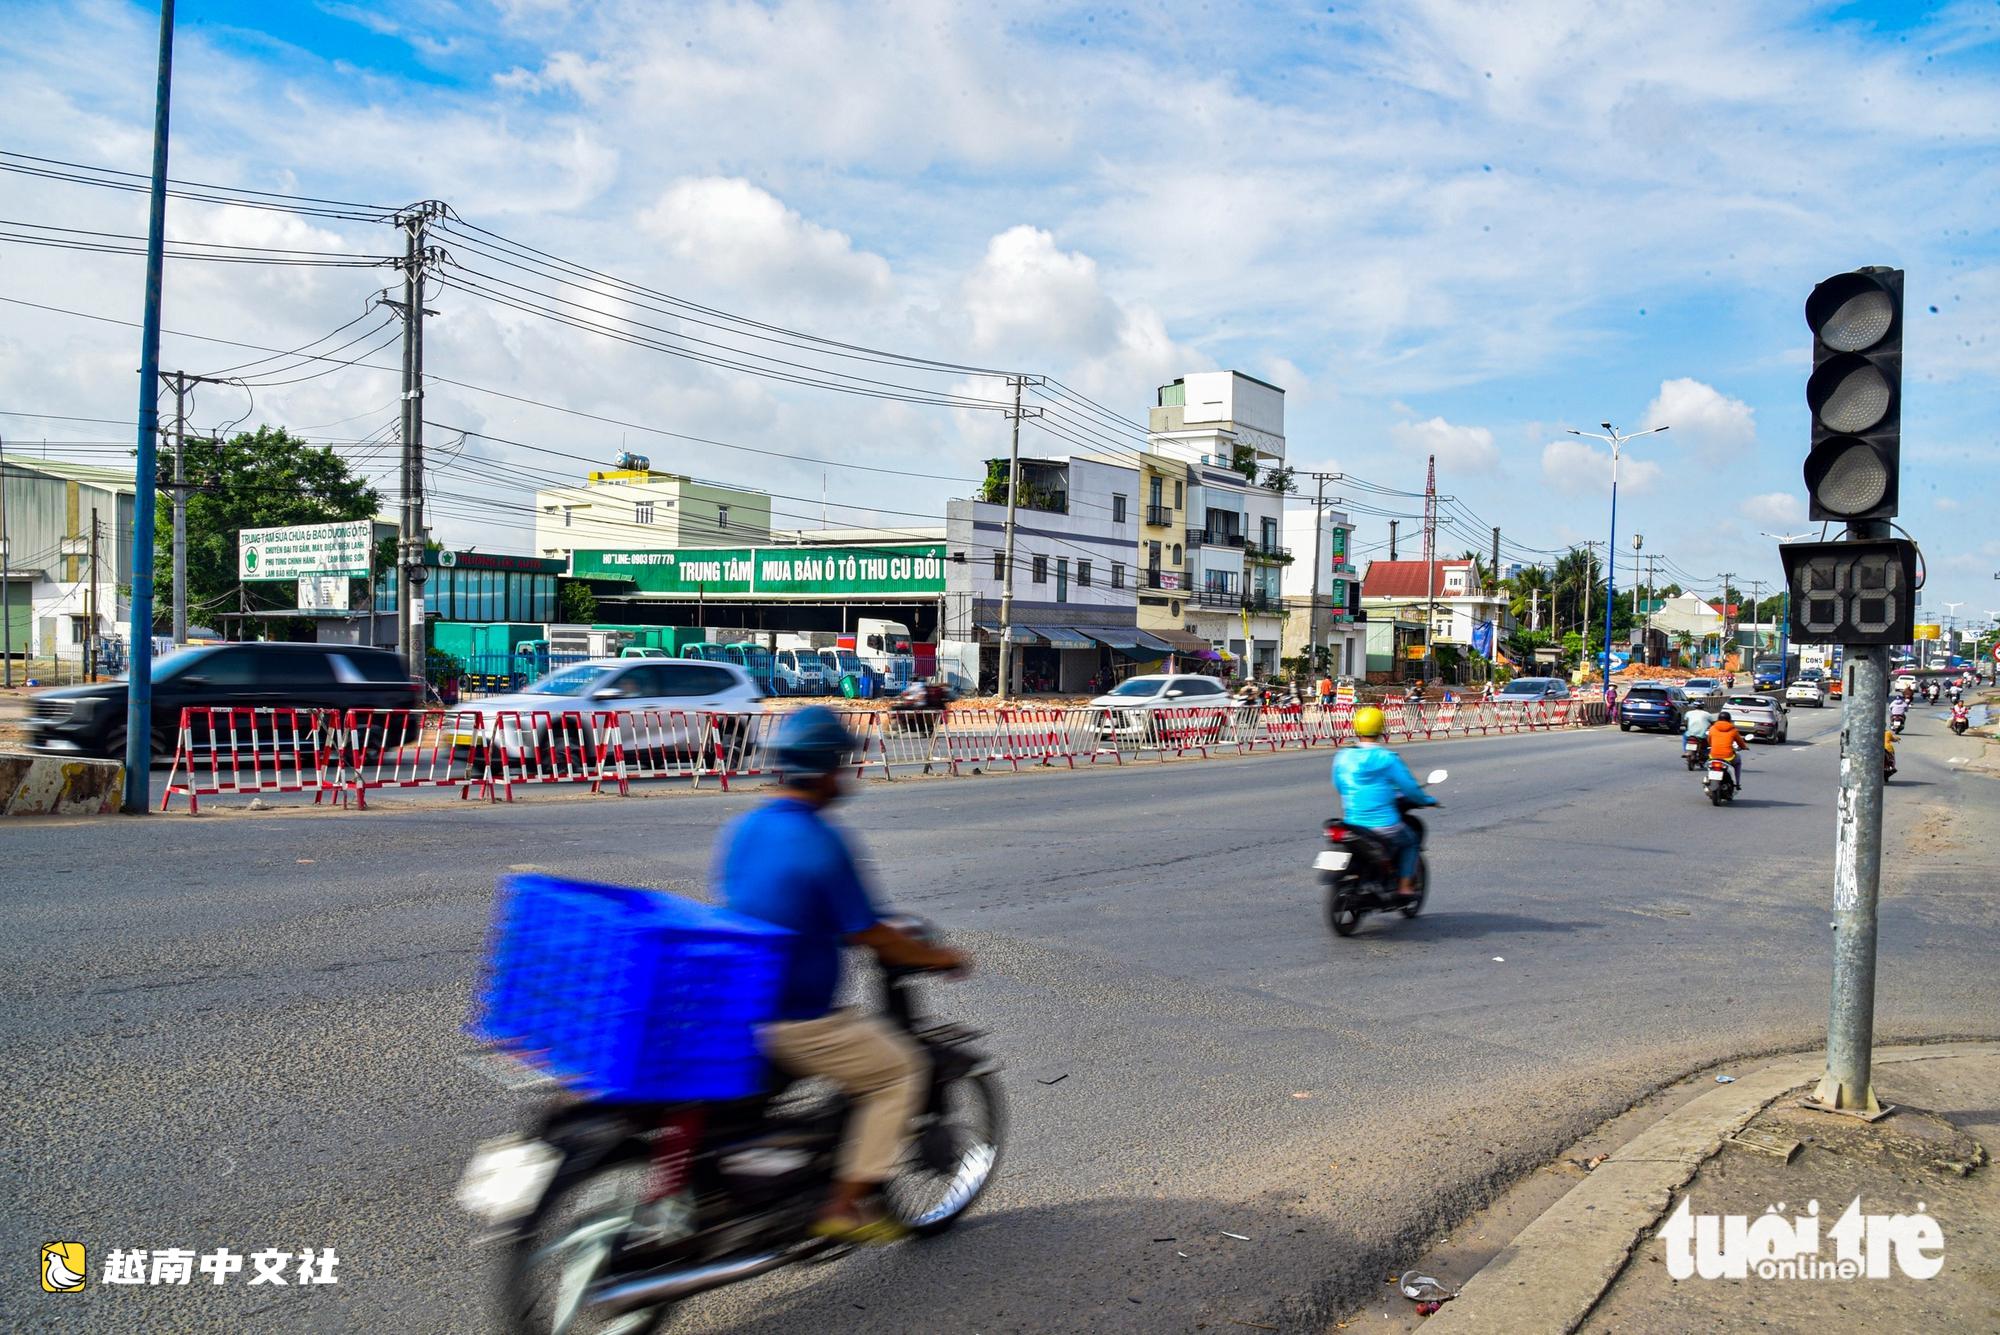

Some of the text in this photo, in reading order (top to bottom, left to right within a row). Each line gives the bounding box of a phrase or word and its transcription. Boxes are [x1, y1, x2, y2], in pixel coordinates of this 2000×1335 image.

[631, 554, 648, 564] 0903
[679, 558, 751, 581] TRUNG TÂM
[762, 560, 791, 581] MUA
[794, 556, 822, 581] BÁN
[825, 556, 835, 580] Ô
[838, 555, 856, 580] TÔ
[859, 558, 887, 580] THU
[914, 549, 940, 579] ĐỔI
